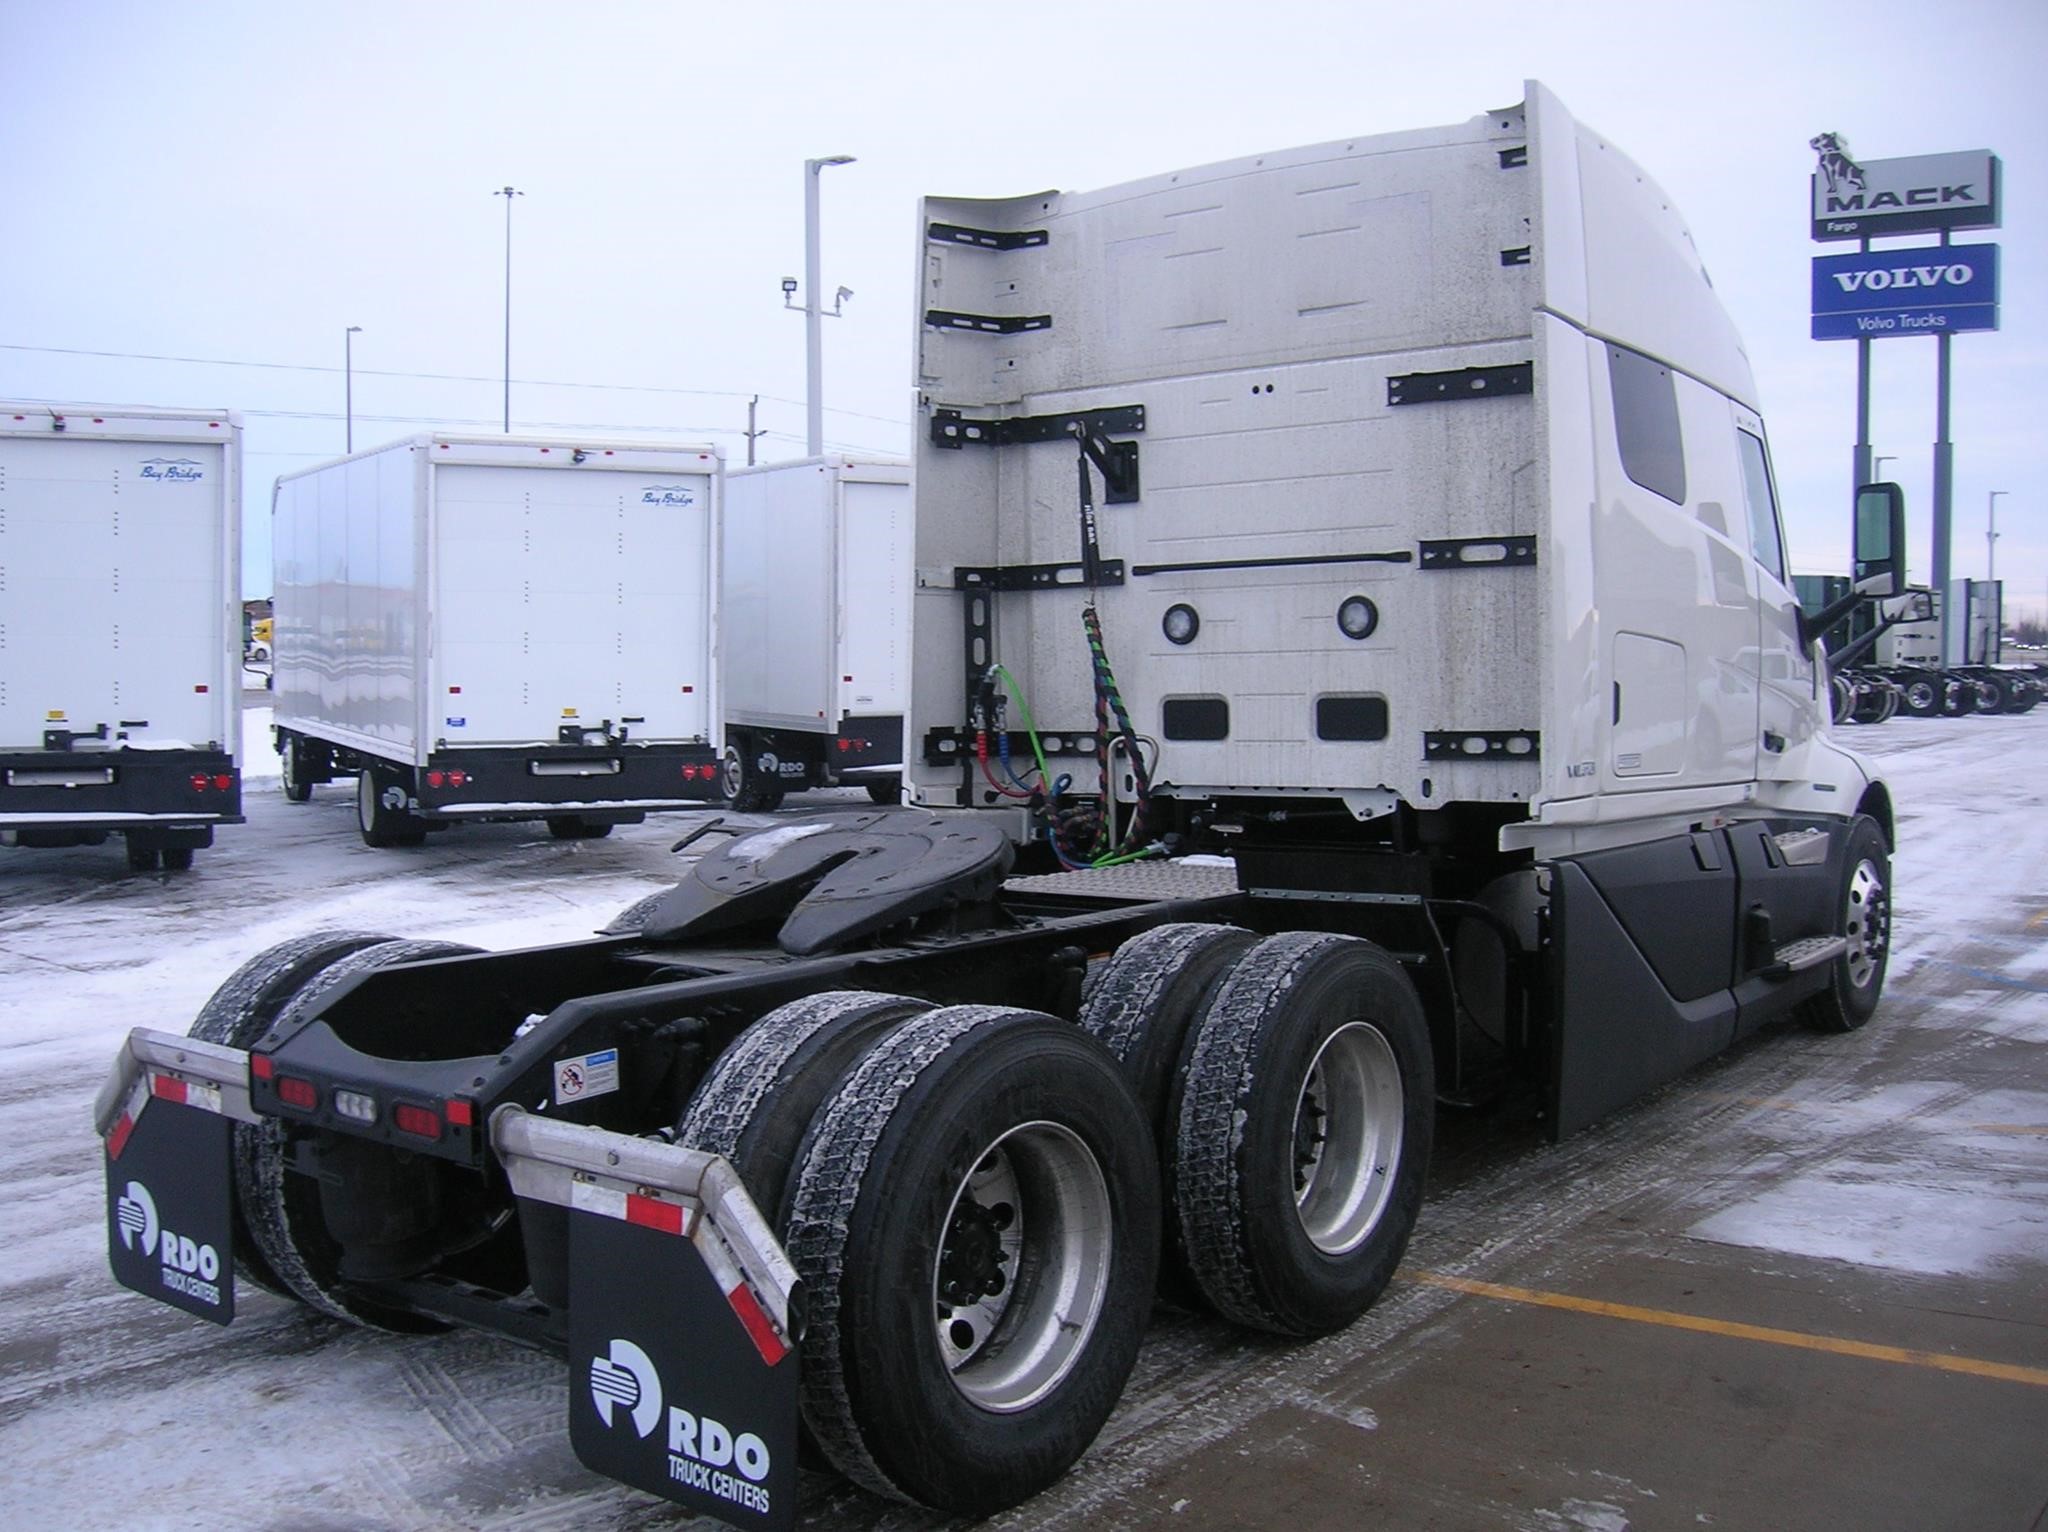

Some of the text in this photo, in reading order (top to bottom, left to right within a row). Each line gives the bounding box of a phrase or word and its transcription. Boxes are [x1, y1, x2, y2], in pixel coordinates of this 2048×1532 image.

[1827, 184, 1975, 213] MACK
[1826, 221, 1858, 234] Fargo
[1833, 263, 1974, 292] VOLVO
[1857, 312, 1947, 331] Volvo Trucks
[140, 466, 203, 481] Bay Bridge
[641, 492, 694, 506] Bay Bridge
[161, 1229, 220, 1281] RDO
[669, 1405, 770, 1481] RDO
[668, 1454, 770, 1514] TRUCK CENTERS
